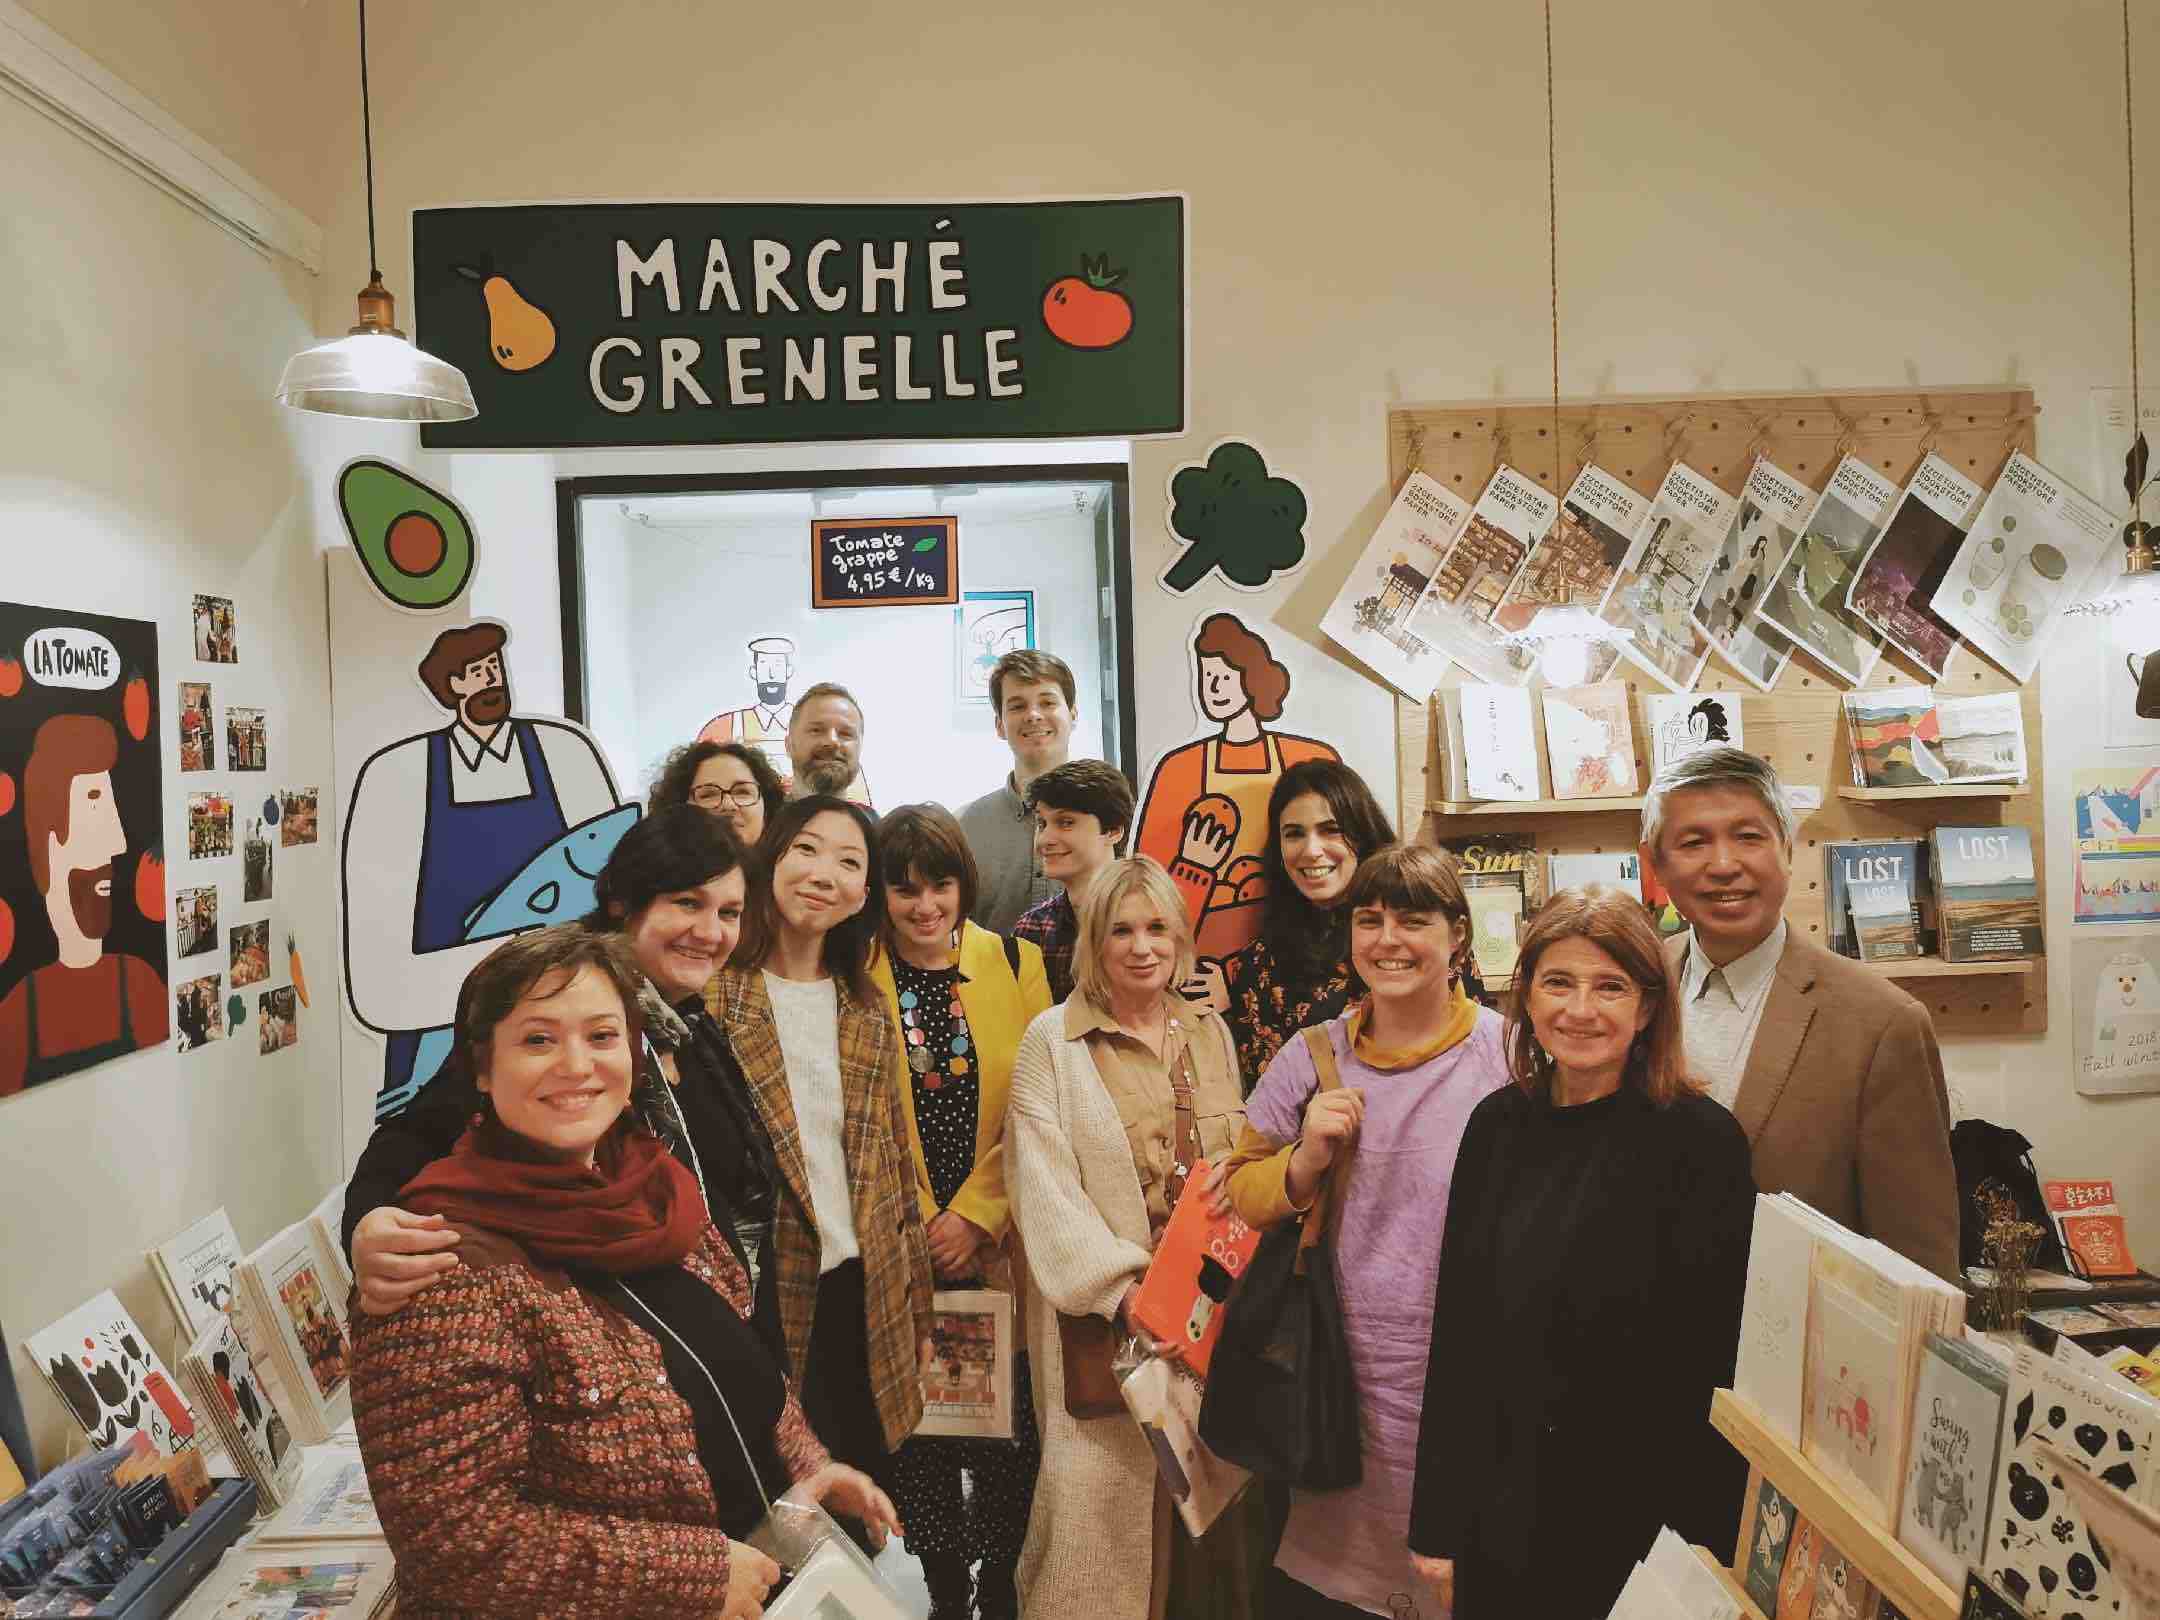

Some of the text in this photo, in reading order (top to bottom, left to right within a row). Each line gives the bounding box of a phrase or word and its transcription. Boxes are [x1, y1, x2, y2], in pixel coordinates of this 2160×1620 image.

[615, 218, 967, 318] MARCHÉ
[588, 329, 1024, 413] GRENELLE
[1493, 482, 1545, 520] BOOKSTORE
[1666, 477, 1715, 516] BOOKSTORE
[2007, 465, 2053, 505] BOOKSTORE
[829, 532, 905, 552] Tomate
[831, 548, 899, 574] grappe
[33, 638, 53, 677] LA
[1958, 835, 2009, 861] LOST
[1845, 856, 1903, 882] LOST
